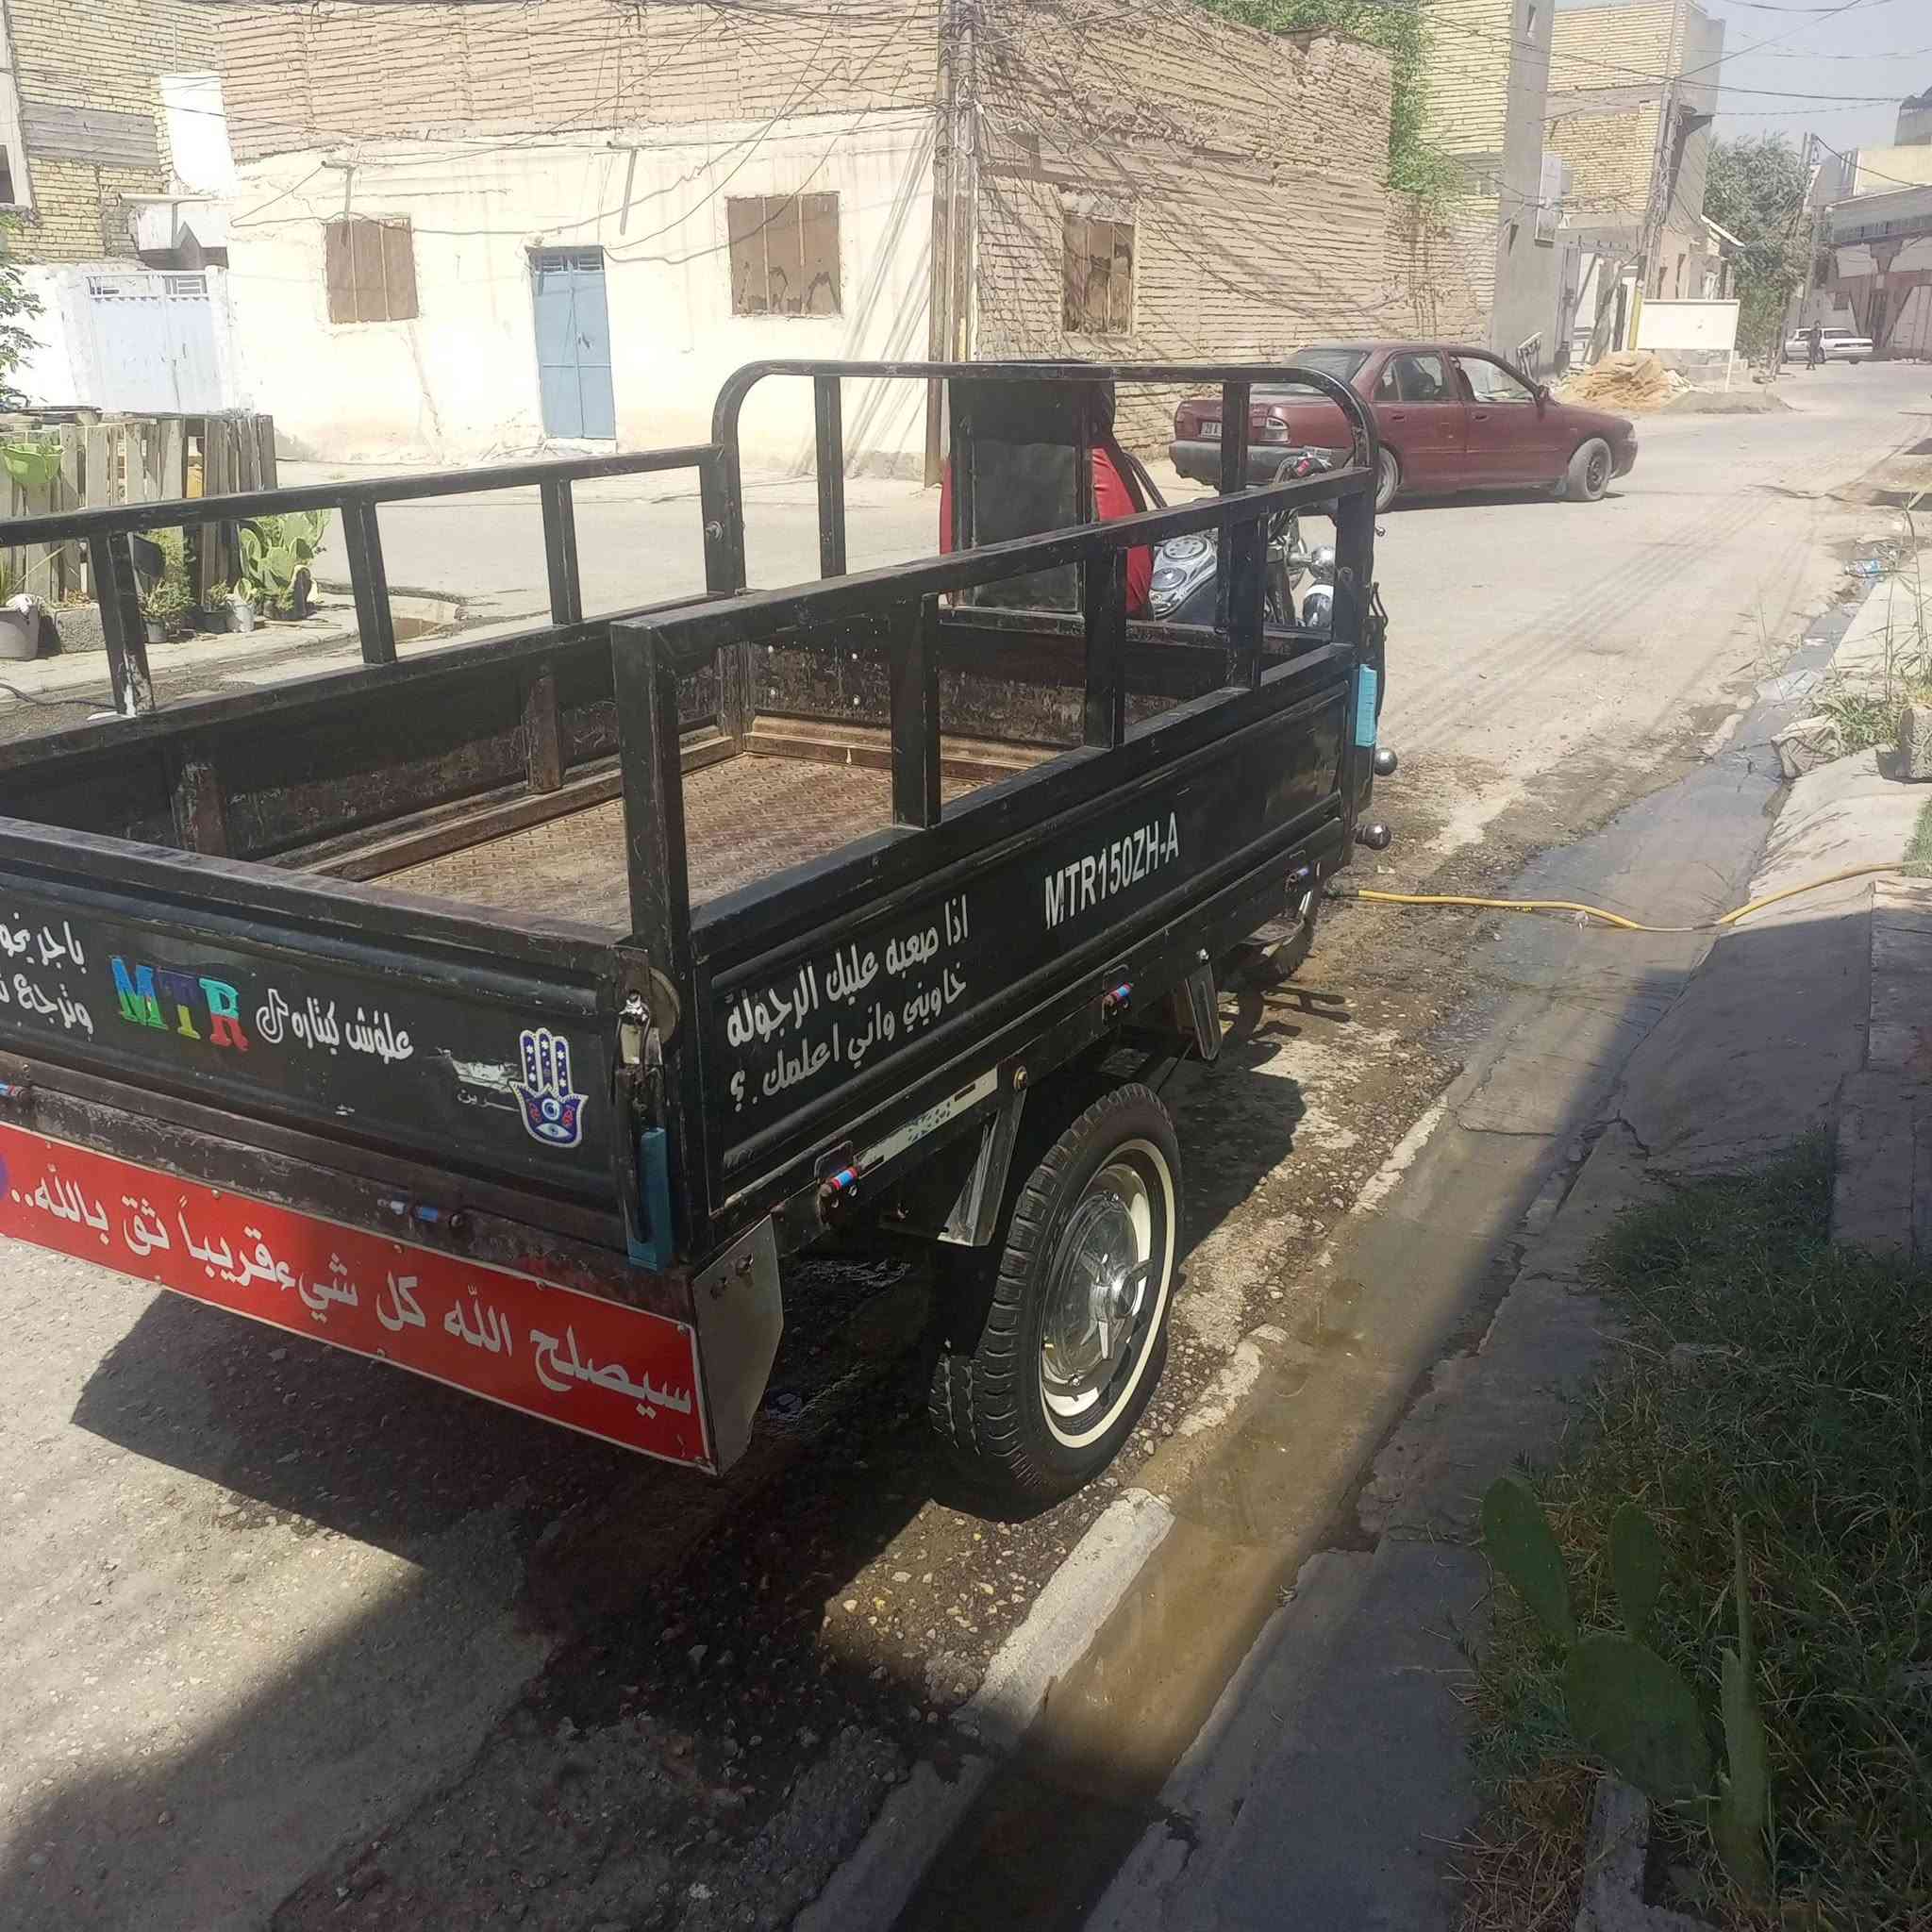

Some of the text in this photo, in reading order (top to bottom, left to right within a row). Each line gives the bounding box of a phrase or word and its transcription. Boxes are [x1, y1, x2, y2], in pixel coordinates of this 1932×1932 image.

[1045, 811, 1179, 930] MTR150ZH-A
[108, 954, 249, 1052] MTR
[727, 894, 968, 1047] اذا صعبه عليك الرجوله
[762, 1022, 840, 1096] اعلمك
[848, 1002, 895, 1069] واني
[121, 1194, 171, 1257] ثق
[376, 1271, 425, 1332] كل
[529, 1324, 691, 1420] سيصلح
